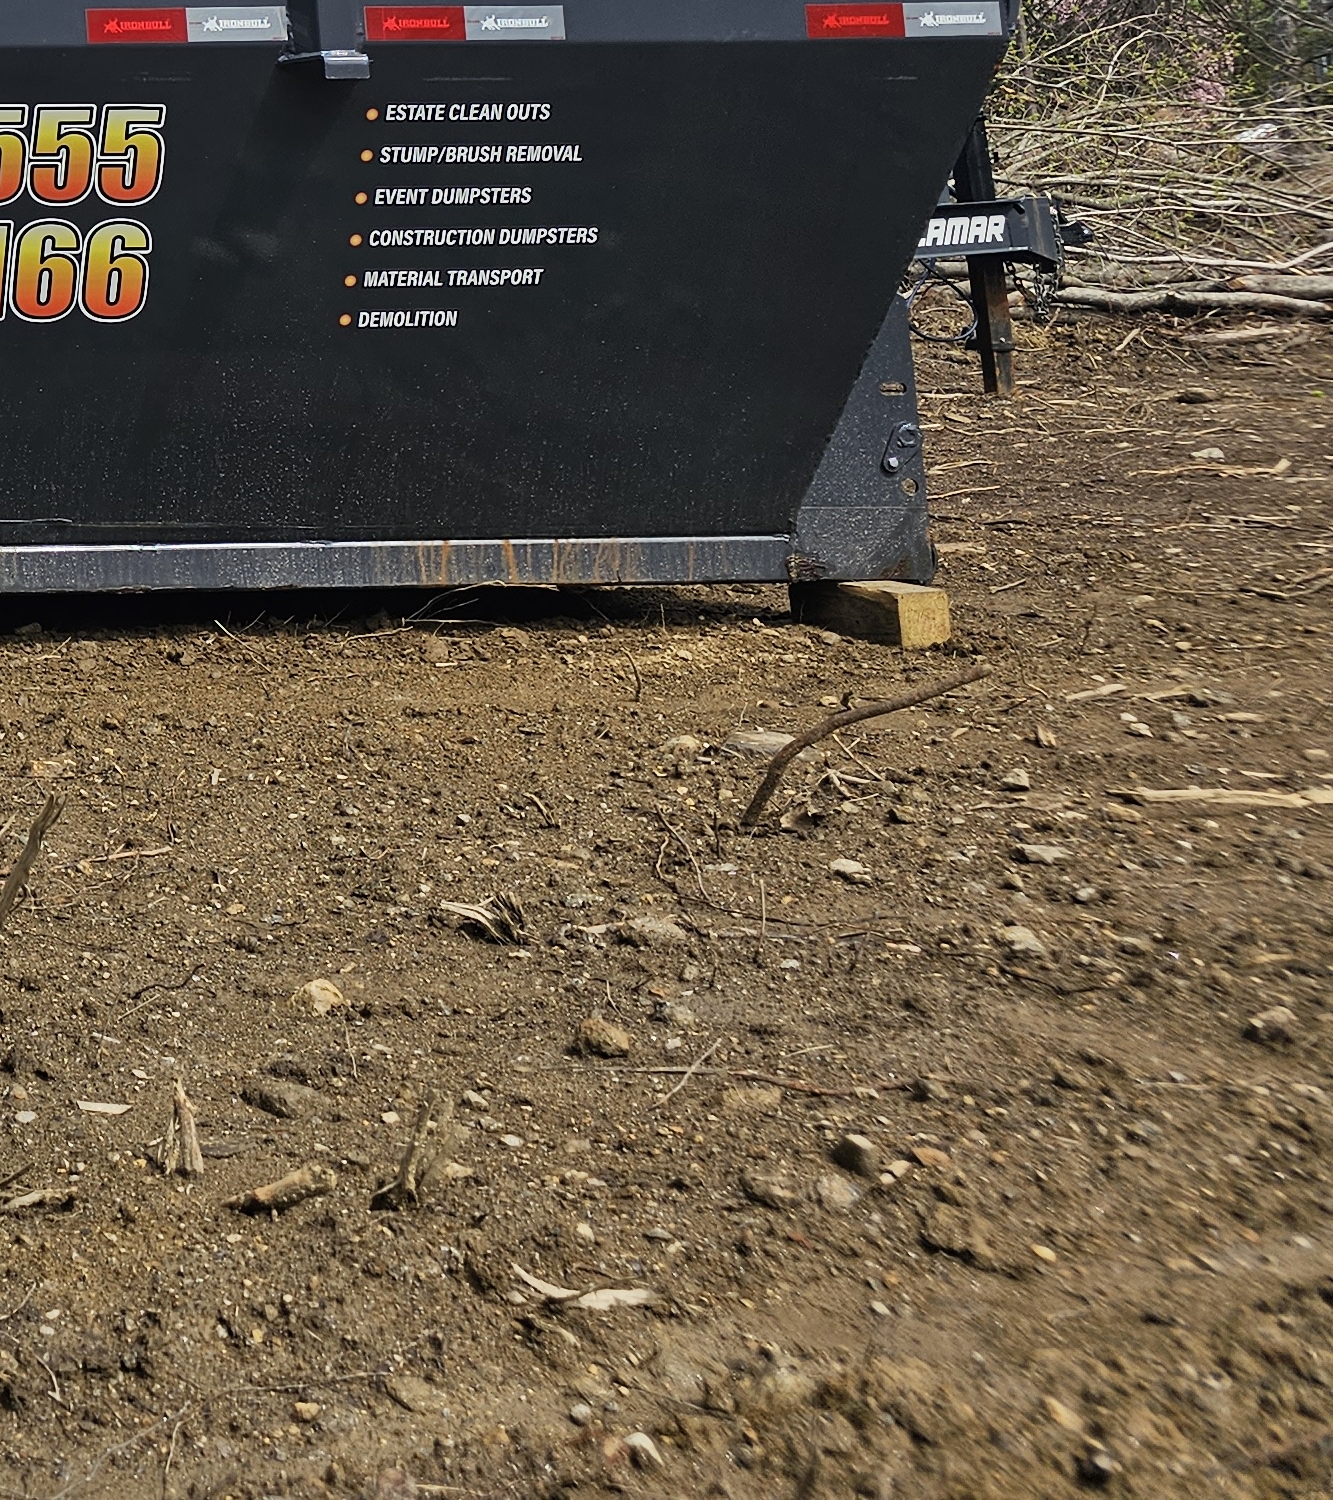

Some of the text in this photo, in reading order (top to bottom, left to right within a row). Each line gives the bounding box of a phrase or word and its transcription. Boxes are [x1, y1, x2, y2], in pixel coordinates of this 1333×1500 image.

[119, 20, 172, 31] IRONBULL
[219, 18, 271, 29] IRONBULL
[398, 18, 450, 29] IRONBULL
[497, 16, 549, 28] IRONBULL
[935, 13, 987, 25] IRONBULL
[385, 103, 551, 121] ESTATE CLEAN OUTS
[379, 145, 583, 163] STUMP/BRUSH REMOVAL
[374, 187, 532, 205] EVENT DUMPSTERS
[369, 227, 599, 246] CONSTRUCTION DUMPSTERS
[363, 269, 544, 287] MATERIAL TRANSPORT
[358, 311, 458, 328] DEMOLITION
